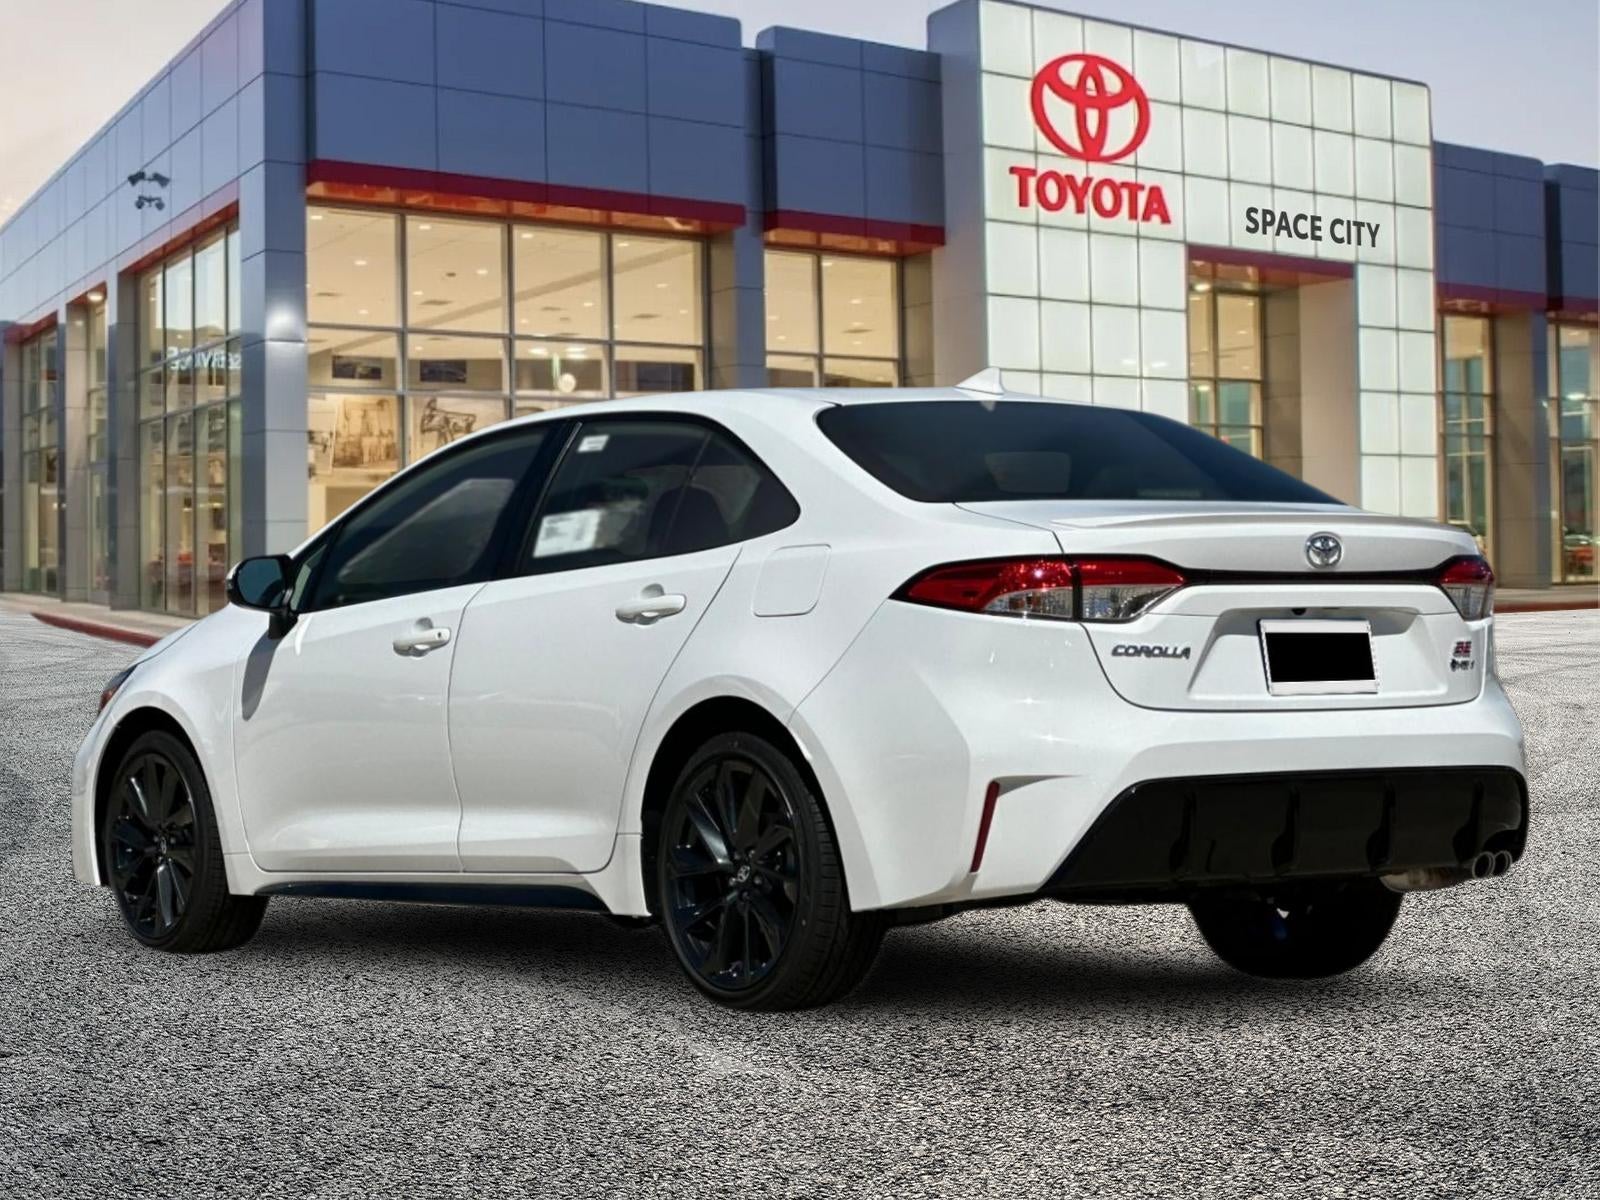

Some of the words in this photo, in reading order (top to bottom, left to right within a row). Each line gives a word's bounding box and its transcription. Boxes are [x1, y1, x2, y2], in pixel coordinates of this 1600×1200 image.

[1009, 166, 1171, 225] TOYOTA
[1245, 206, 1323, 242] SPACE
[1329, 218, 1381, 248] CITY
[1111, 644, 1191, 660] COROLLA
